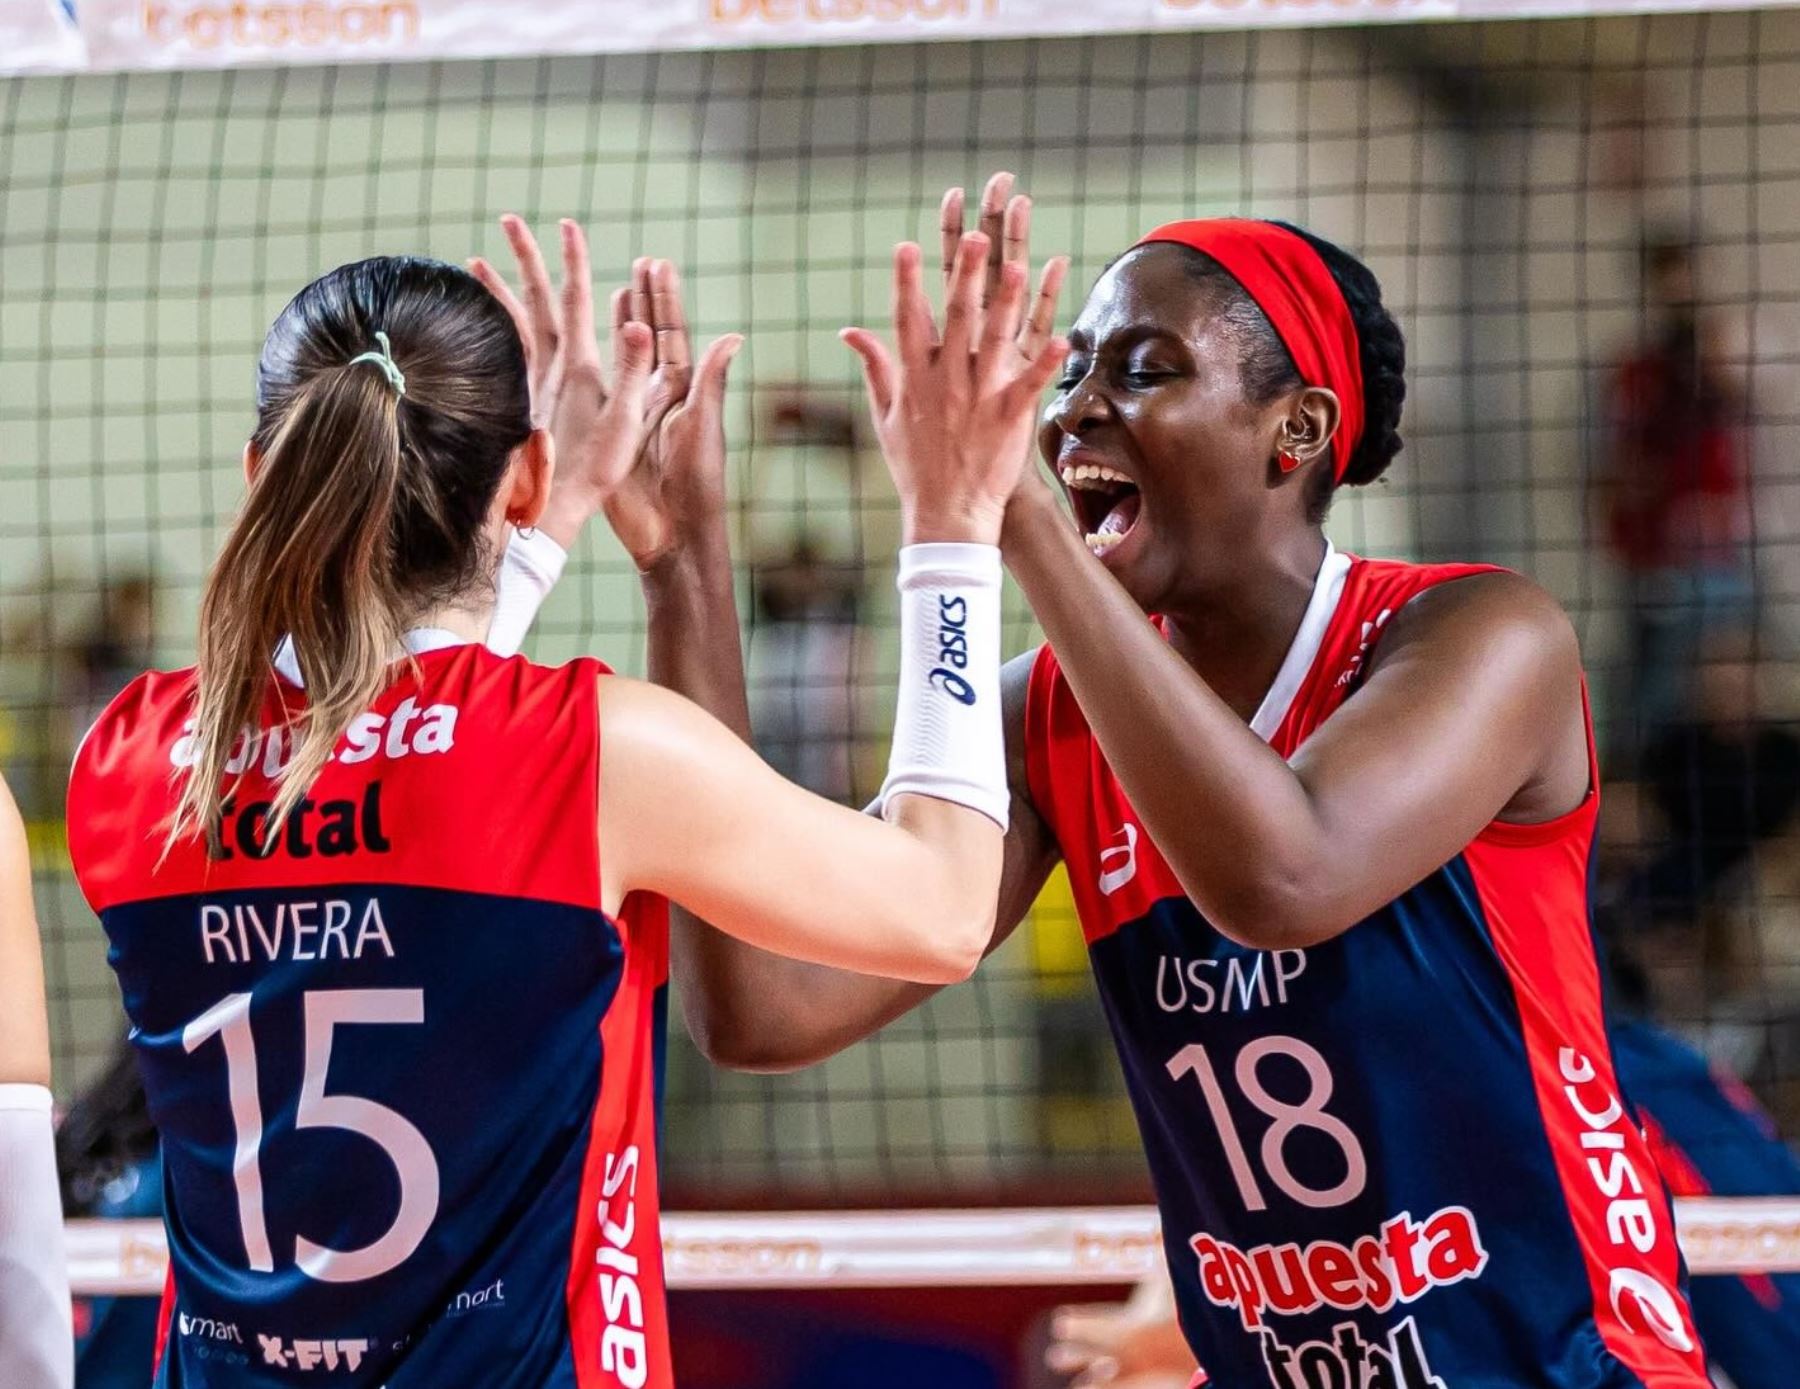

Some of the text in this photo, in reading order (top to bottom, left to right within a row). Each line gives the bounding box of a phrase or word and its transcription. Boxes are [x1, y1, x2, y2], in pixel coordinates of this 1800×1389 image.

[938, 593, 967, 669] asics
[200, 898, 396, 964] RIVERA
[1156, 948, 1307, 1014] USMP
[182, 987, 441, 1284] 15
[1165, 1034, 1368, 1211] 18
[595, 1144, 649, 1389] asics
[1189, 1205, 1489, 1333] apuesta
